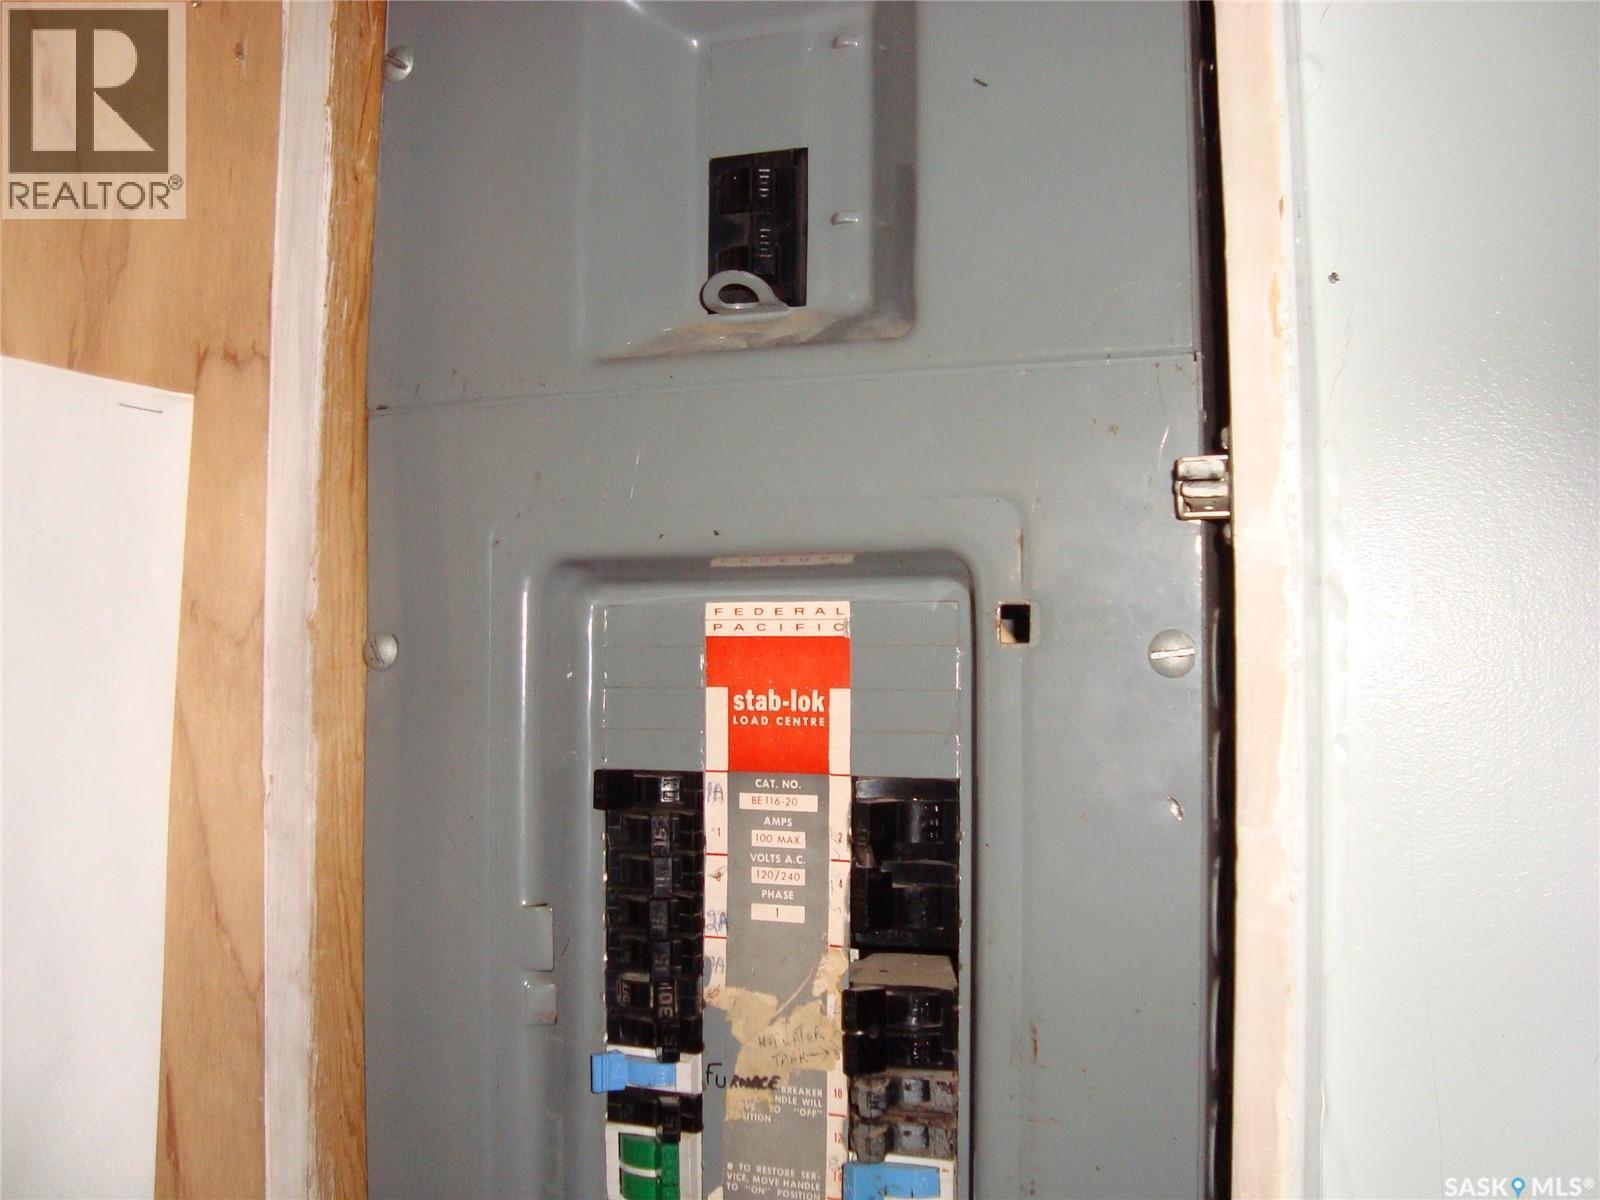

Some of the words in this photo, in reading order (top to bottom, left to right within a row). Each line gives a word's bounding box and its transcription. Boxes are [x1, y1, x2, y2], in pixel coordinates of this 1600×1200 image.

[713, 607, 846, 616] FEDERAL
[713, 623, 847, 632] PACIFIC
[732, 688, 826, 713] stab-lok
[732, 715, 769, 726] LOAD
[776, 716, 826, 727] CENTRE
[754, 778, 779, 789] CAT.
[782, 780, 802, 790] NO.
[763, 816, 793, 827] AMPS
[755, 833, 773, 844] 100
[838, 832, 843, 843] 2
[750, 852, 781, 864] VOLTS
[785, 854, 806, 865] A.C.
[755, 869, 801, 882] 120/240
[838, 878, 843, 888] 4
[761, 889, 795, 900] PHASE
[775, 907, 779, 918] 1
[706, 1062, 781, 1090] FURNACE
[781, 1087, 823, 1098] BREAKER
[773, 1095, 798, 1106] NDLE
[801, 1098, 823, 1108] WILL
[738, 1162, 751, 1173] TO
[756, 1165, 796, 1178] RESTORE
[752, 1175, 780, 1187] MOVE
[782, 1178, 821, 1192] HANDLE
[726, 1181, 739, 1192] TO
[776, 1188, 821, 1200] POSITION
